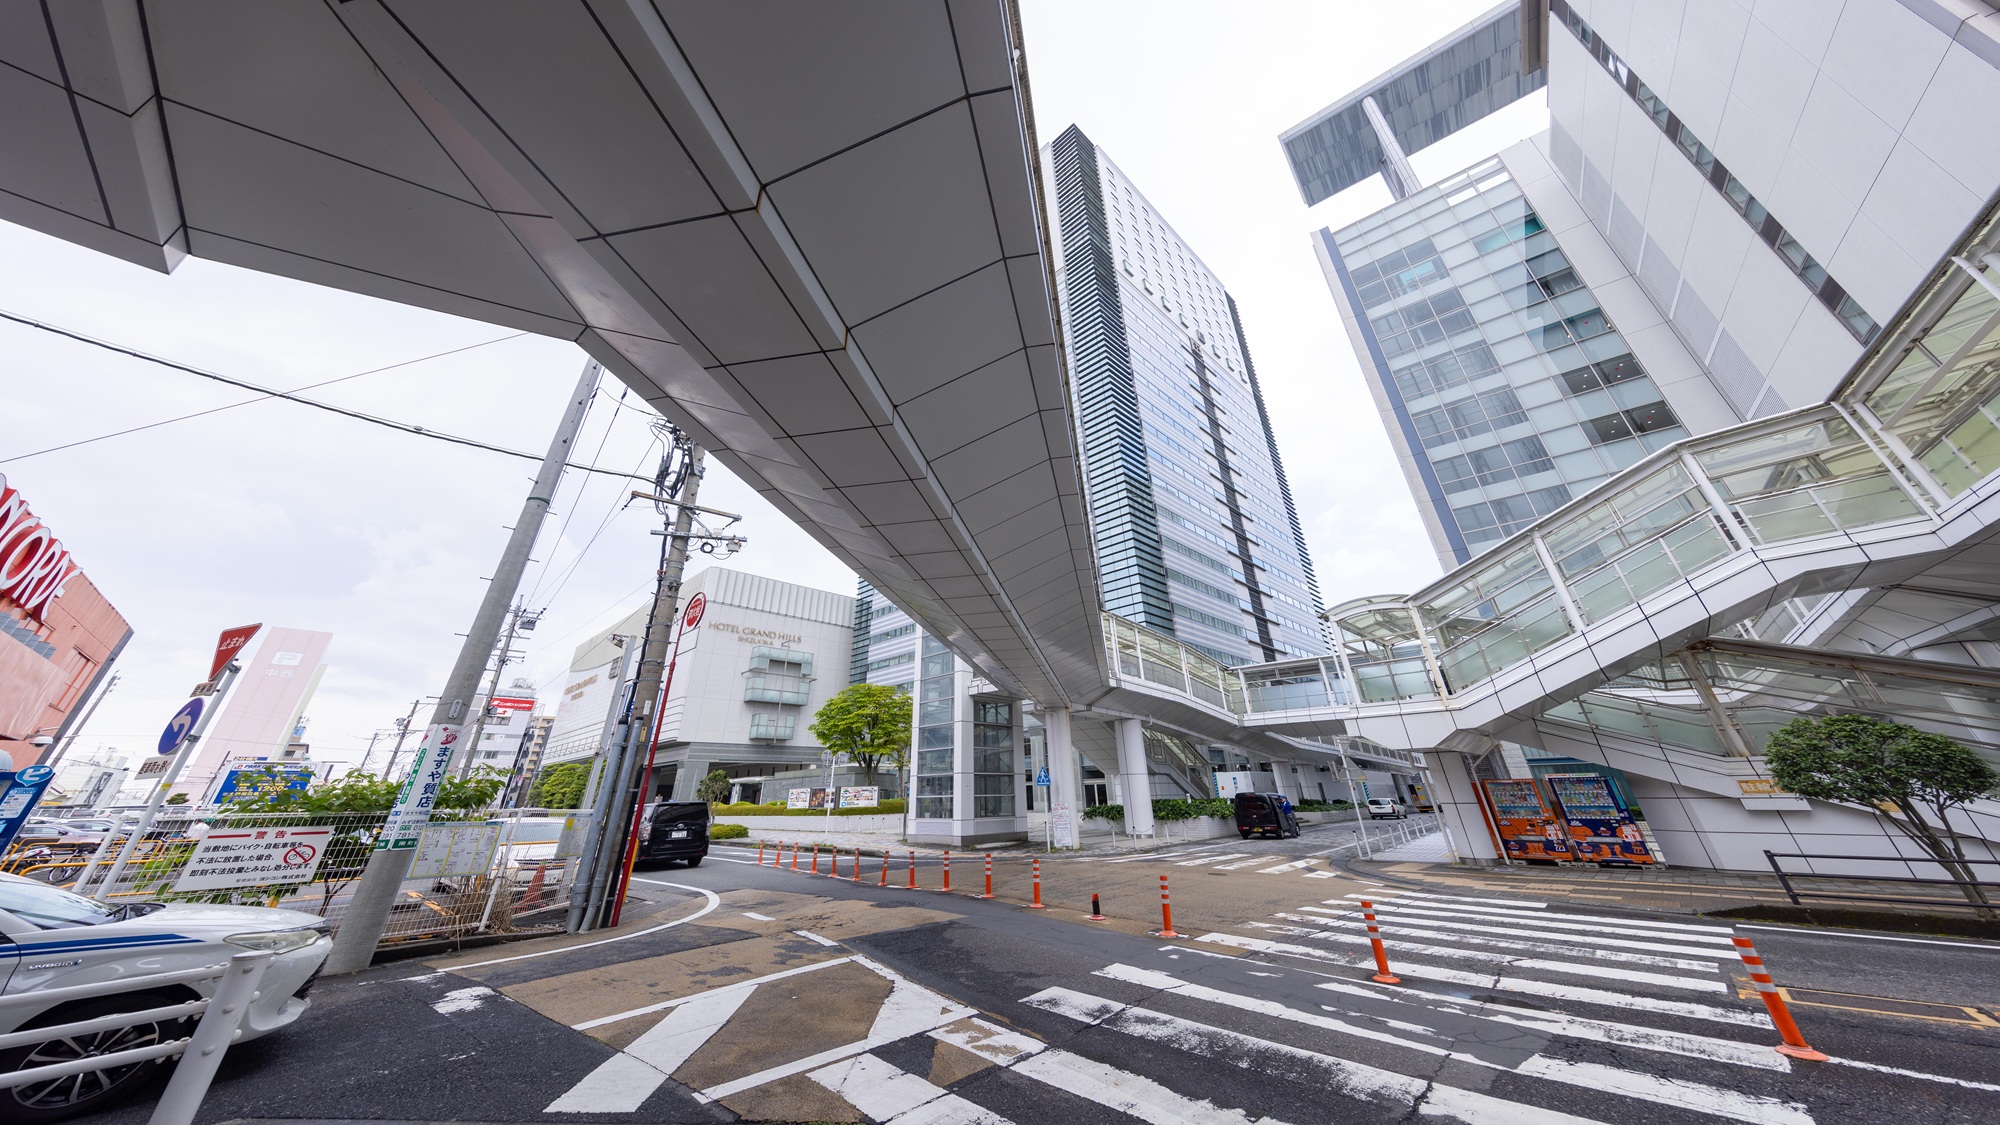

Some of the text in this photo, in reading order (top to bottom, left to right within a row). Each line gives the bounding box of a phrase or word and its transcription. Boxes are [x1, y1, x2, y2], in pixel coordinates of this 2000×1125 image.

[708, 621, 801, 643] HOTEL GRAND HILLS
[219, 635, 245, 650] 止まれ
[738, 636, 773, 646] SHIZUOKA
[277, 653, 298, 663] P
[416, 746, 451, 808] ますや質店
[254, 830, 287, 839] 警告
